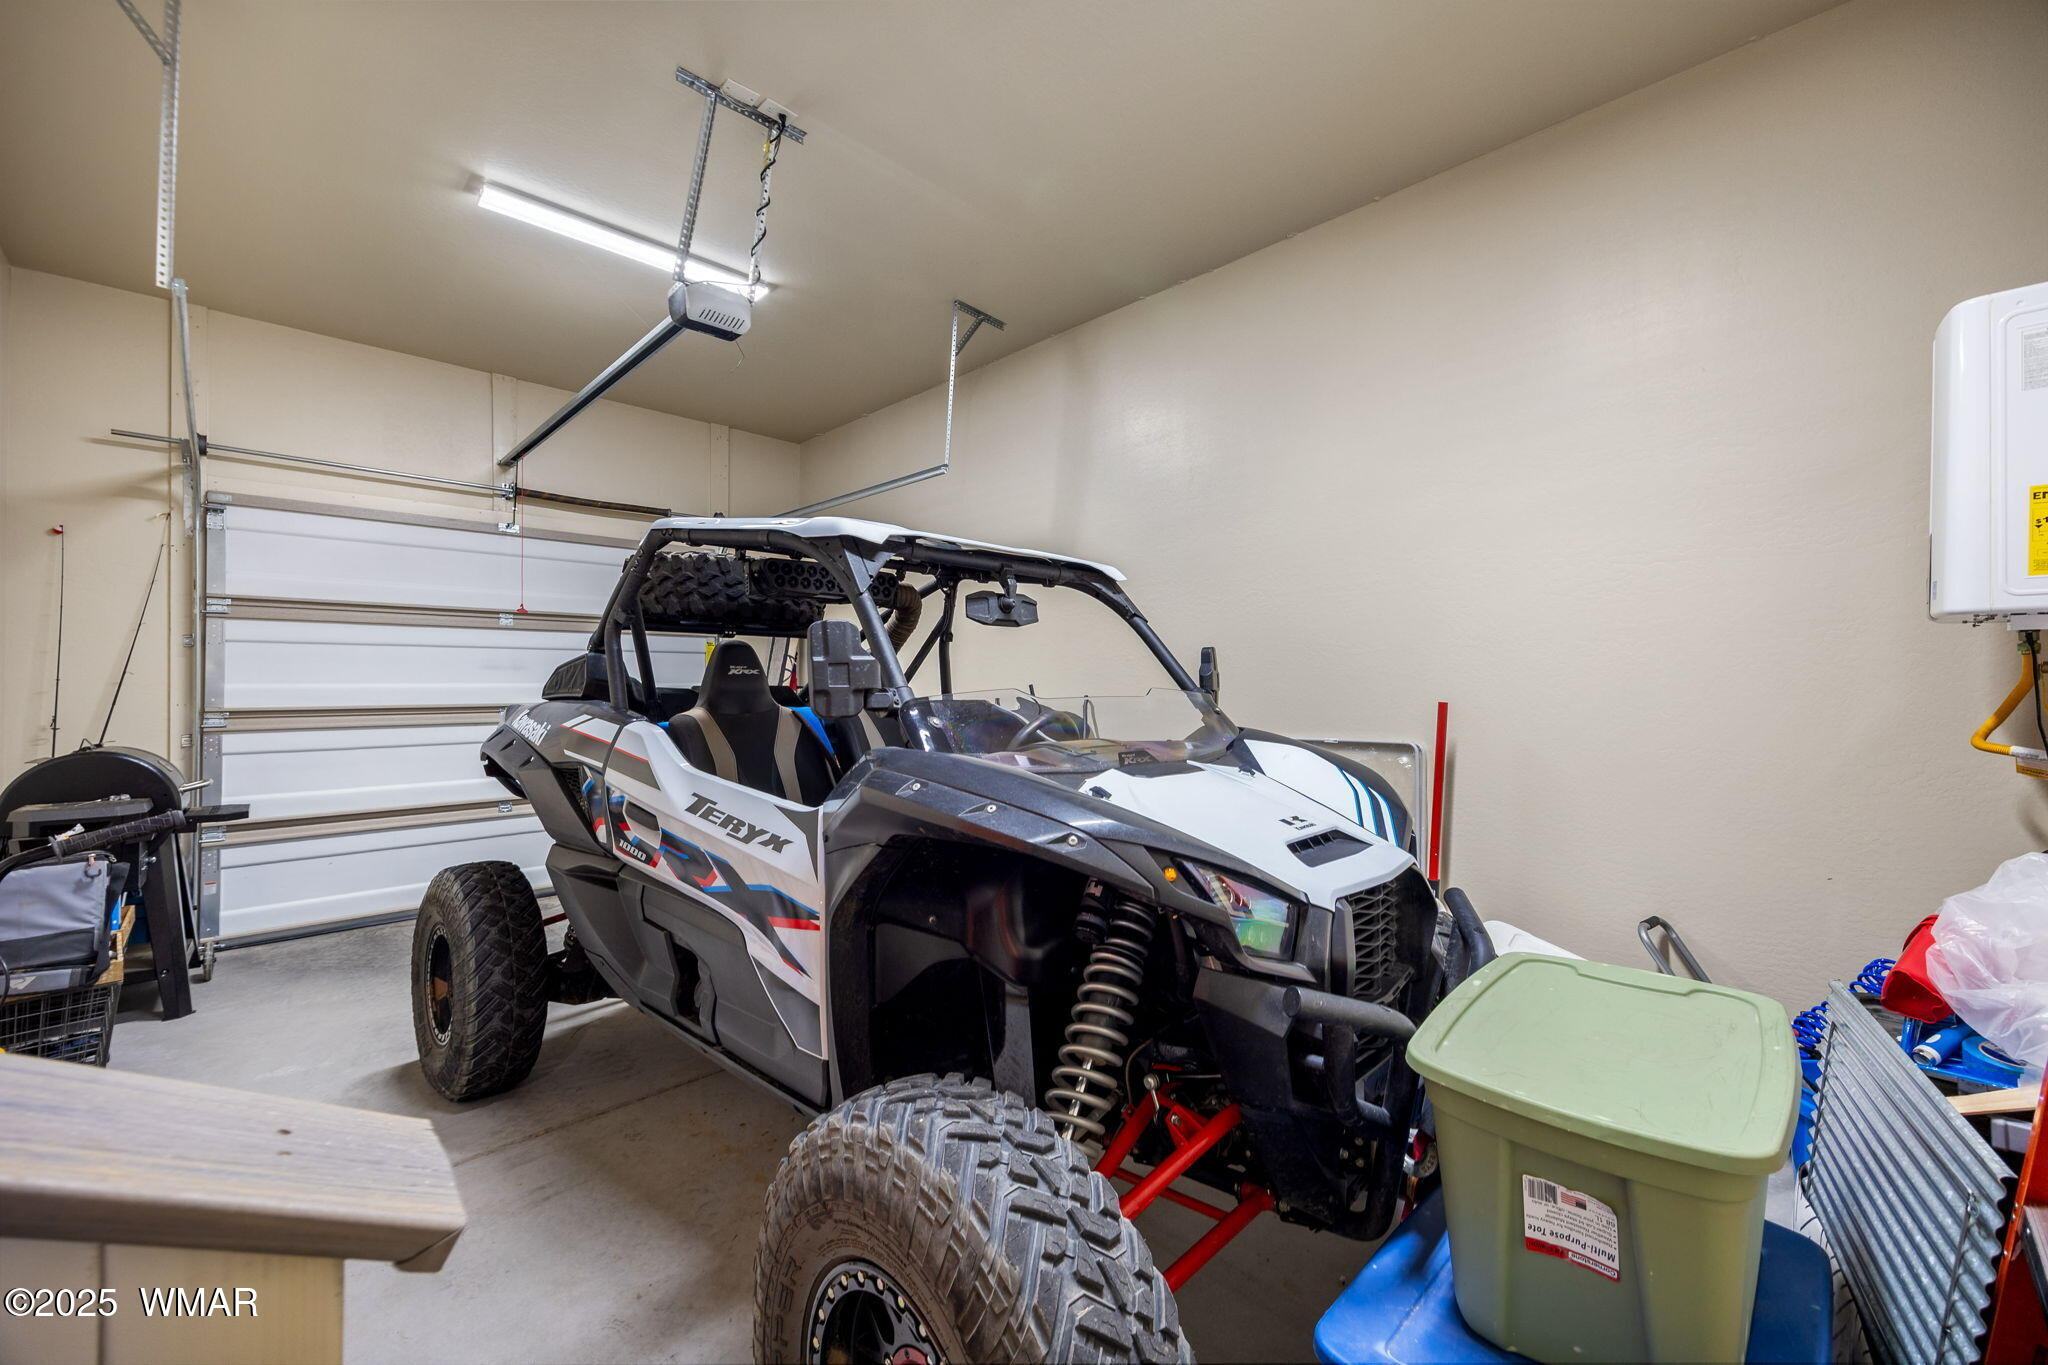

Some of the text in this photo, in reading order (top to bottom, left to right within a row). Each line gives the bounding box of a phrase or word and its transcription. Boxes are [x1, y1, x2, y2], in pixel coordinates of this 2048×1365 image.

[511, 709, 551, 746] Kawasaki
[684, 792, 794, 854] TERYX
[619, 838, 647, 861] 1000
[1527, 1222, 1615, 1262] Multi-Purpose Tote
